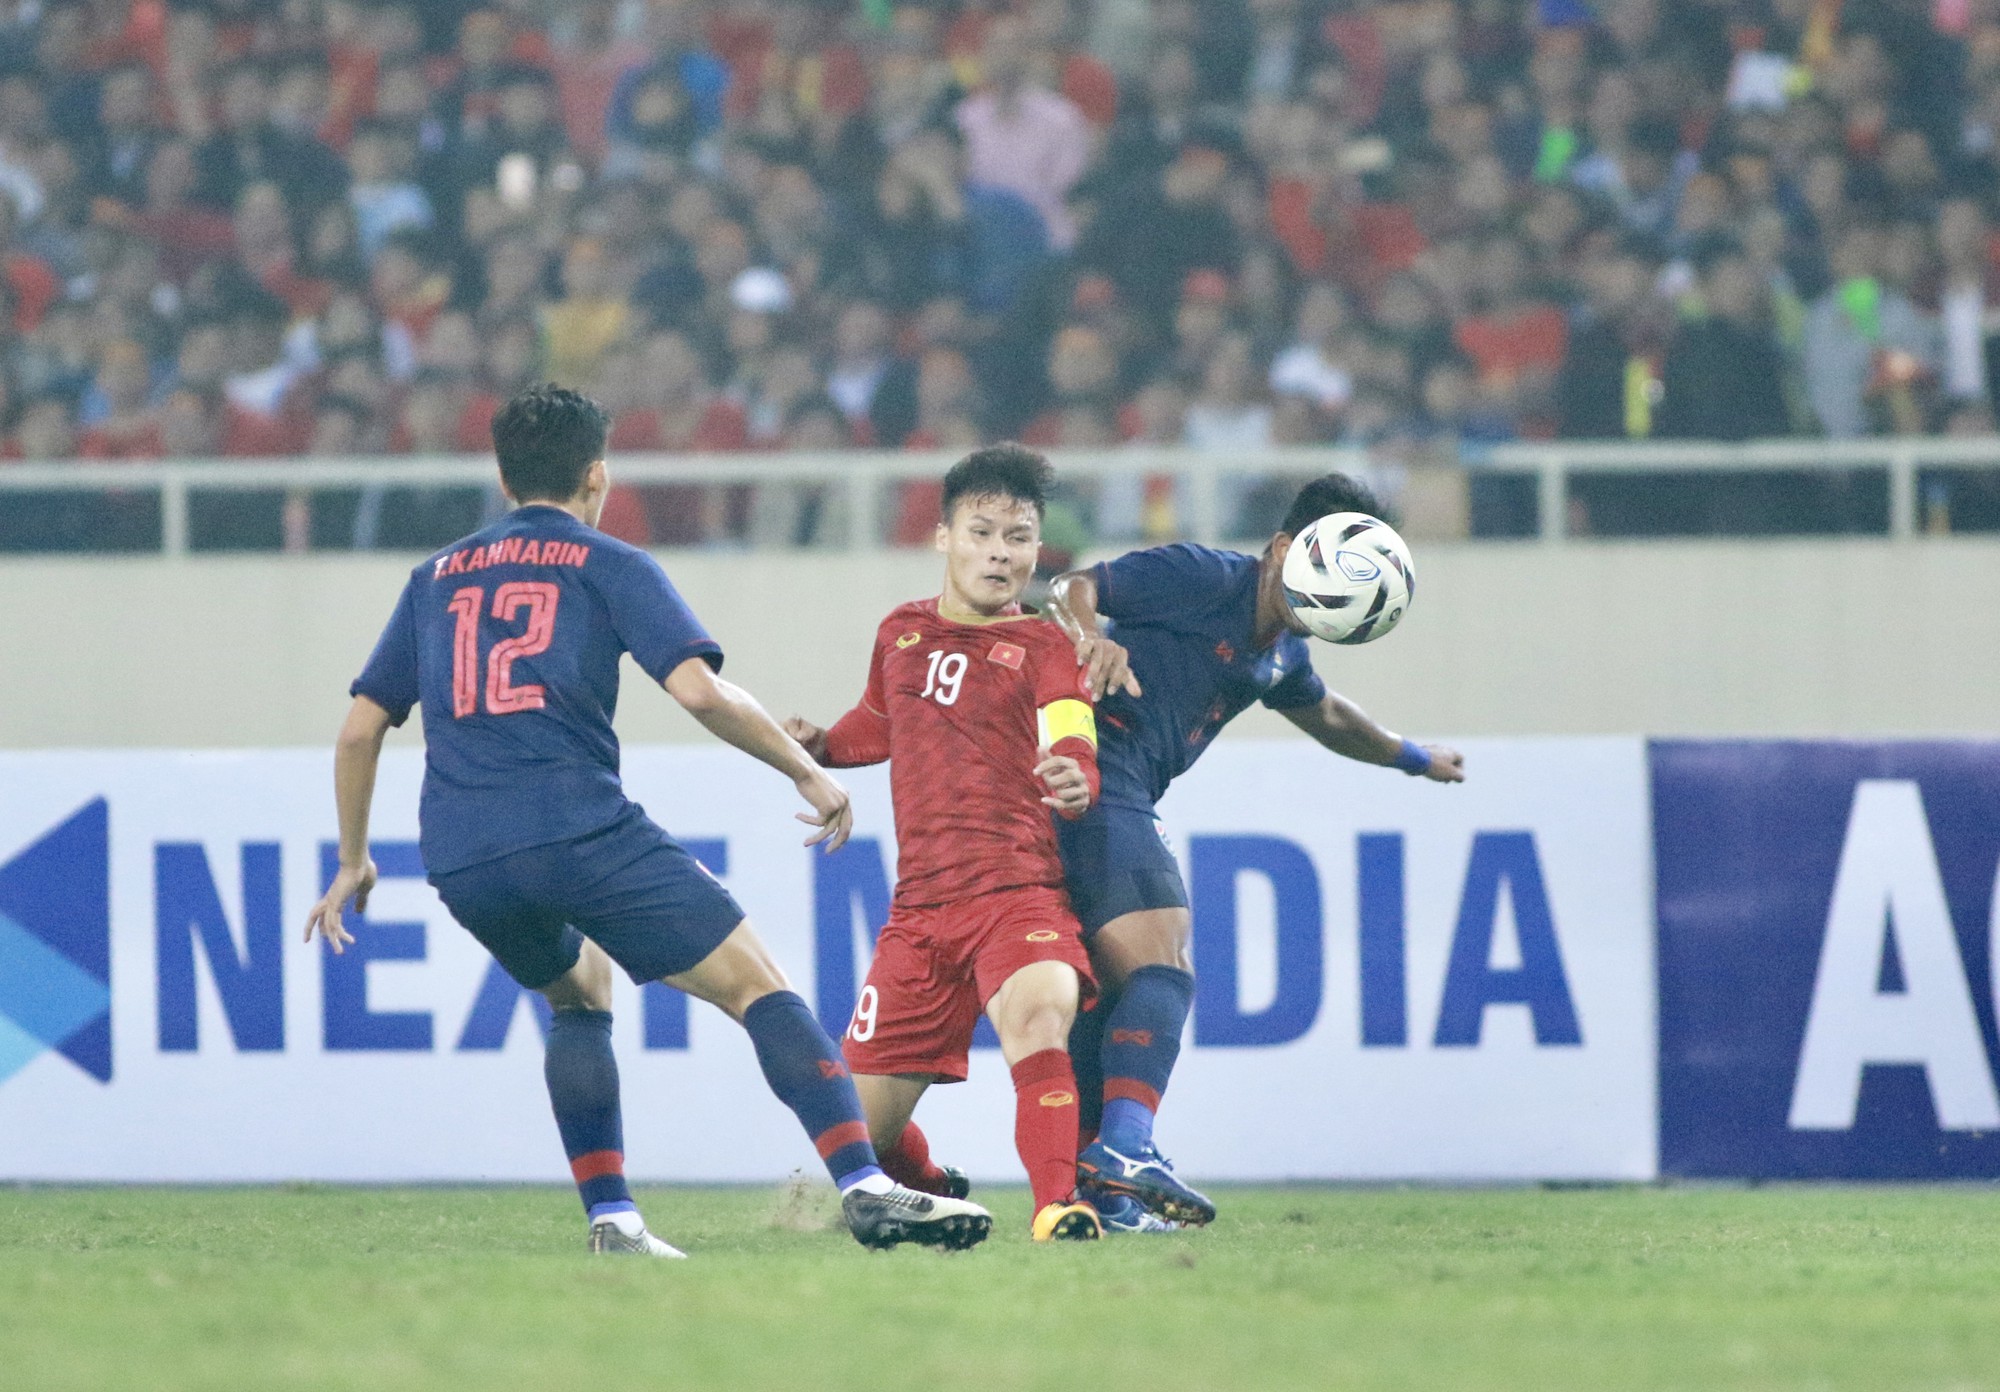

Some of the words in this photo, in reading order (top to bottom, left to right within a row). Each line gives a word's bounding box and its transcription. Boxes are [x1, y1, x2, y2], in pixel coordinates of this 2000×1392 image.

[434, 537, 589, 580] T.KANNARIN
[447, 582, 560, 719] 12
[921, 650, 968, 705] 19
[1788, 779, 2000, 1130] A
